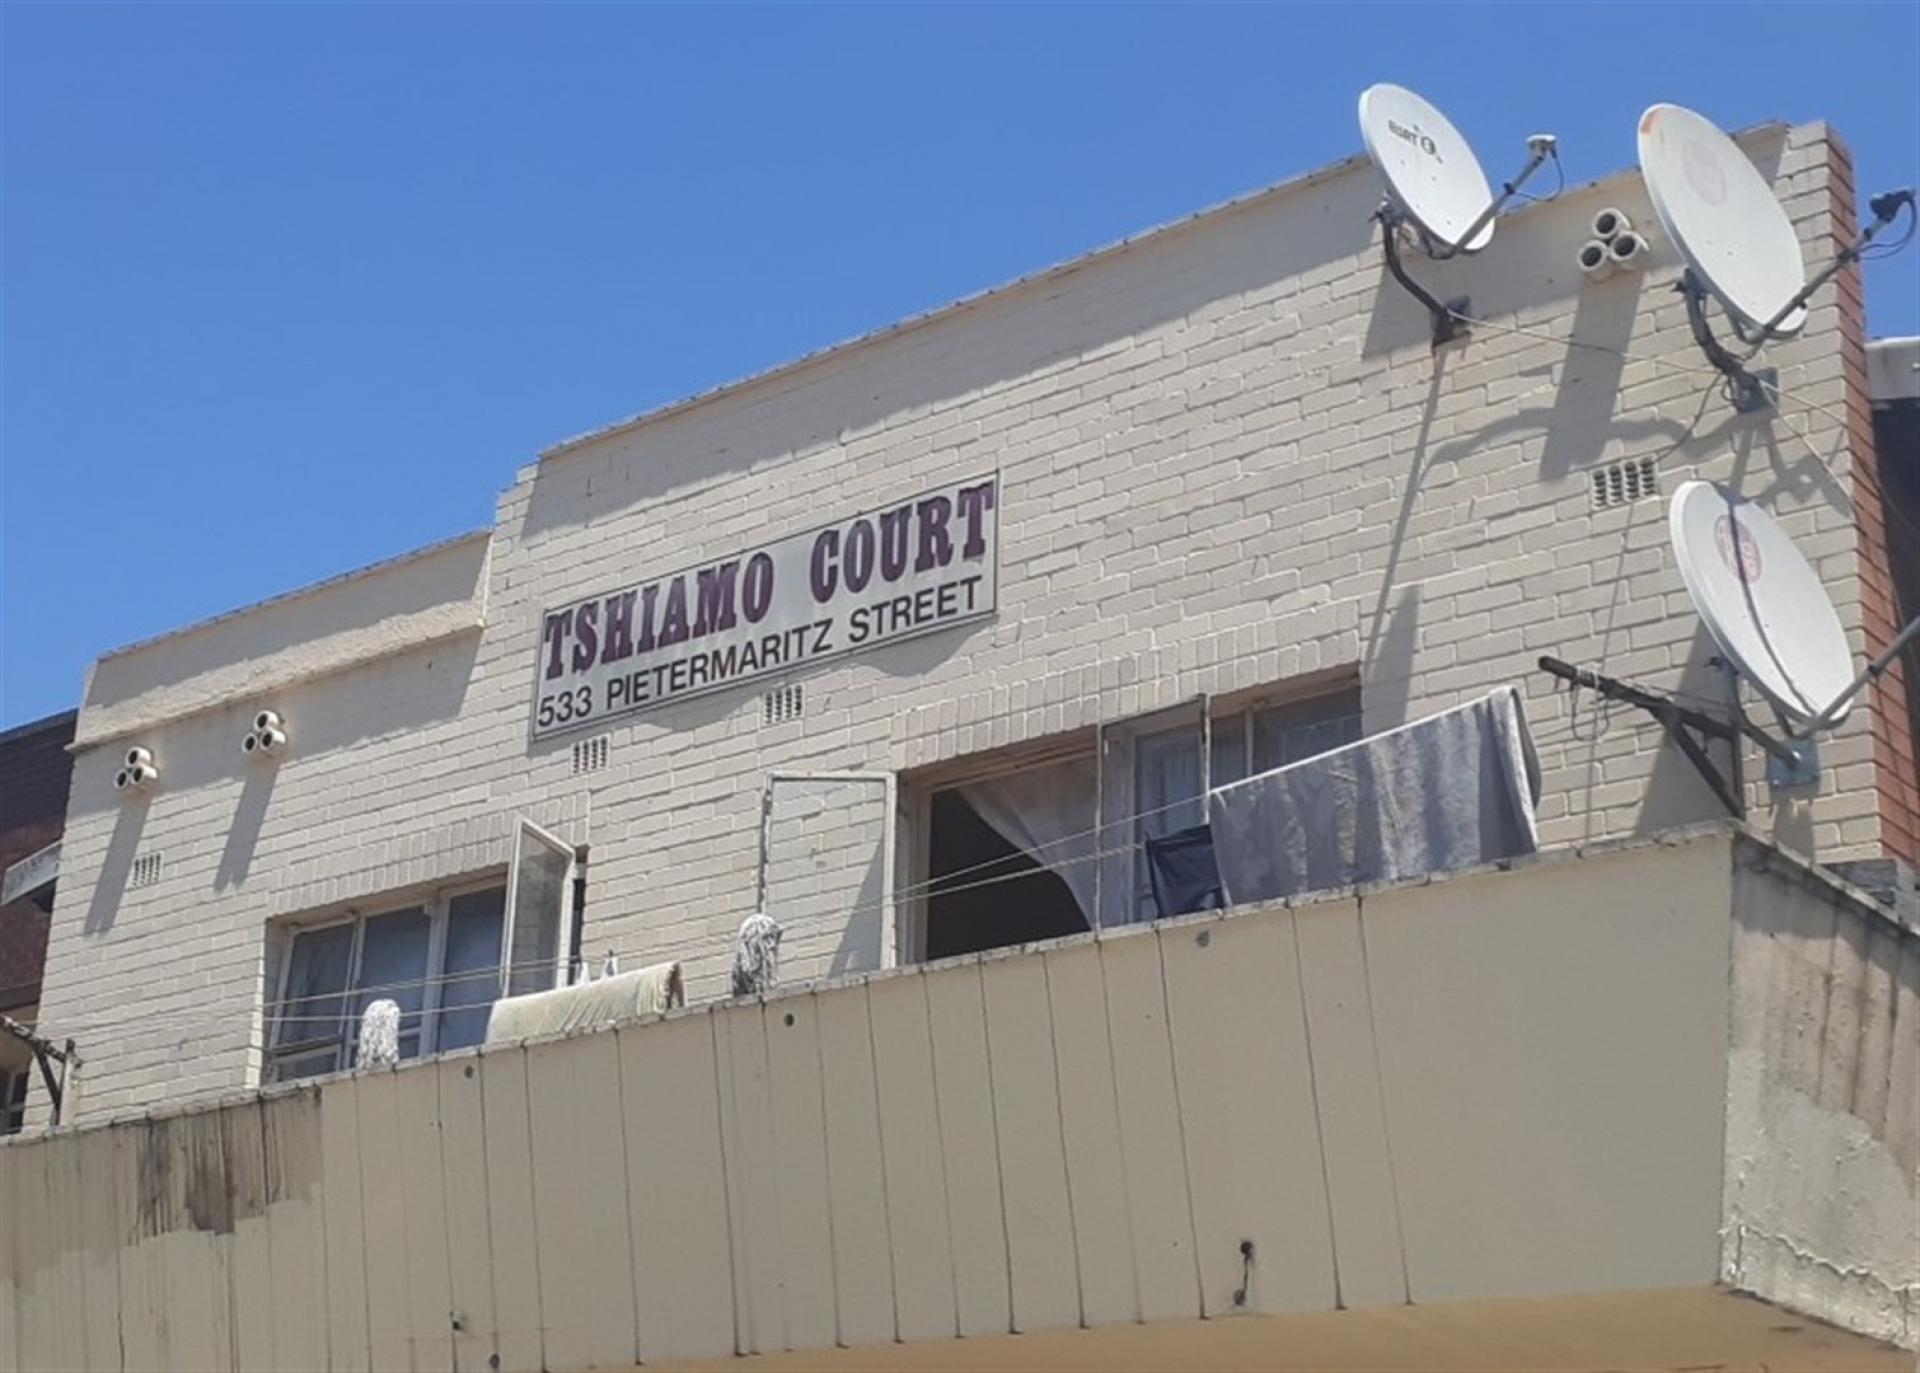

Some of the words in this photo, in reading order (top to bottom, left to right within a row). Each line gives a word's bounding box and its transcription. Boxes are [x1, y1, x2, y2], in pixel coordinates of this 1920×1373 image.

[538, 686, 592, 727] 533
[606, 618, 834, 710] PIETERMARITZ
[848, 575, 983, 643] STREET
[545, 552, 774, 681] TSHIAMO
[810, 480, 994, 604] COURT
